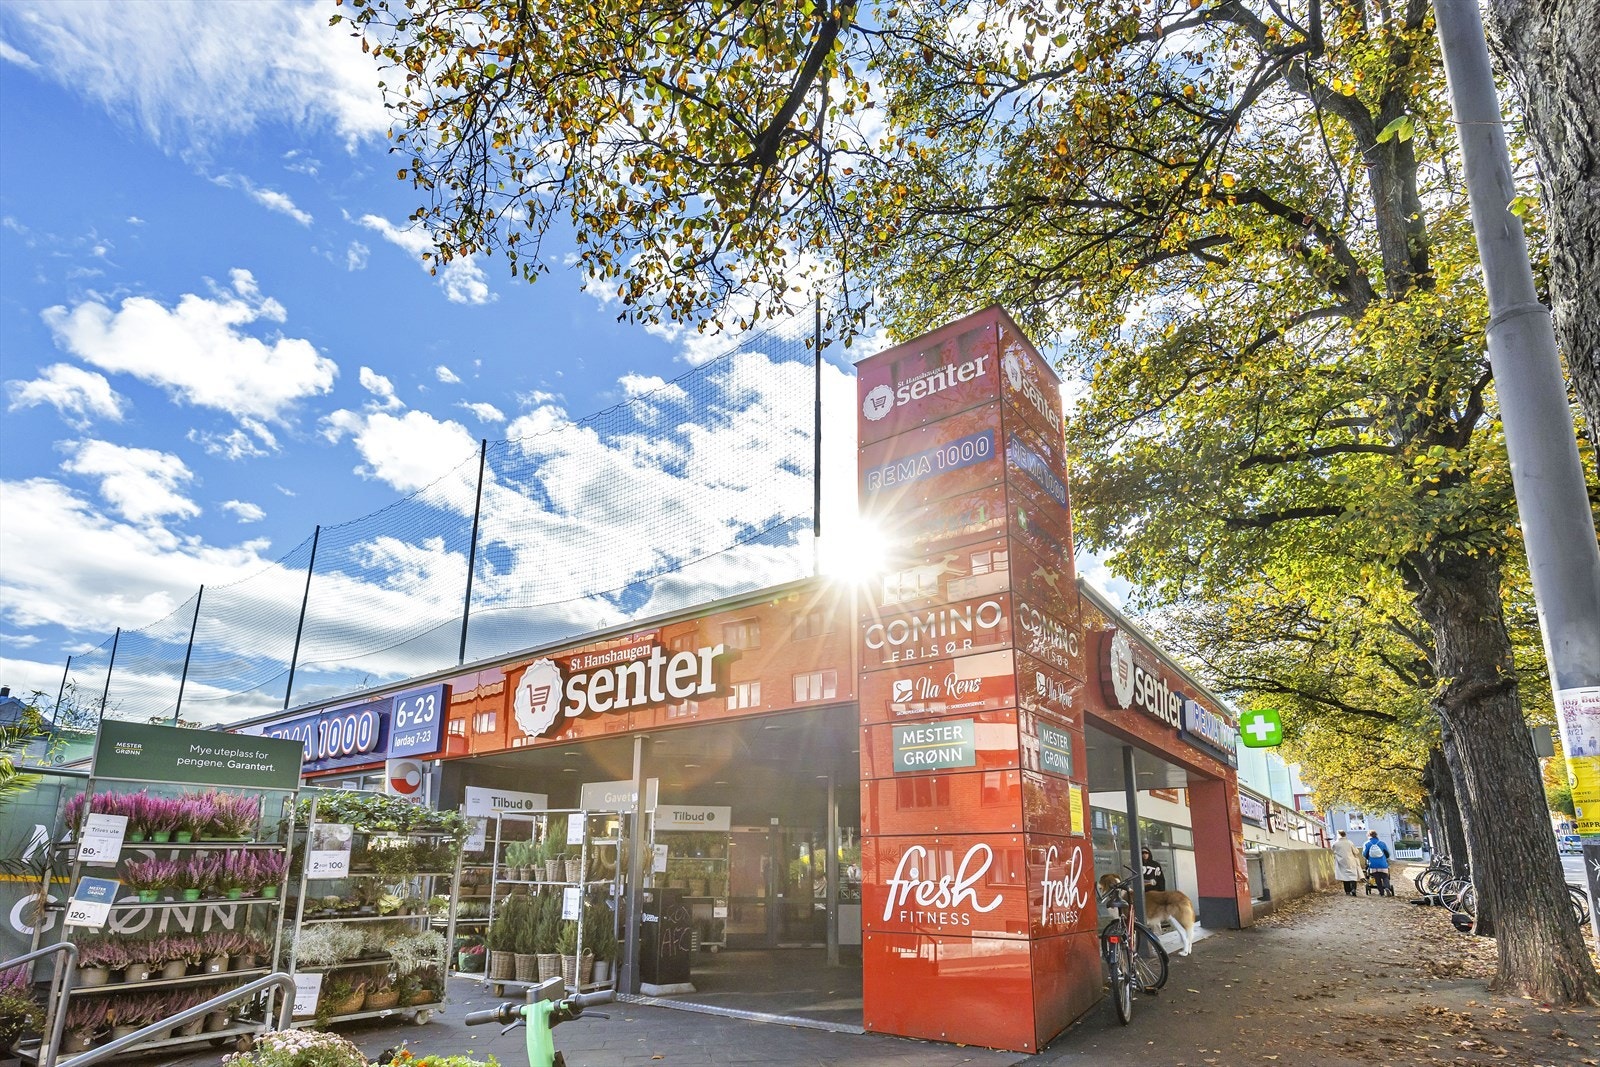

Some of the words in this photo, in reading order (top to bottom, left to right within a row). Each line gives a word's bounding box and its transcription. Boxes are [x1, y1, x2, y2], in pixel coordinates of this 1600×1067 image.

[896, 354, 989, 406] senter
[1021, 378, 1061, 434] senter
[868, 456, 931, 491] REMA
[936, 436, 989, 468] 1000
[865, 600, 1002, 650] COMINO
[1020, 602, 1079, 658] COMINO
[570, 658, 583, 672] St.
[584, 644, 651, 668] Hanshaugen
[564, 643, 724, 718] senter
[944, 672, 982, 700] Rens
[1135, 666, 1182, 731] senter
[396, 694, 435, 728] 6-23
[116, 741, 142, 749] MESTER
[318, 710, 376, 760] 1000
[416, 730, 432, 743] 7-23
[902, 725, 964, 745] MESTER
[1043, 728, 1069, 750] MESTER
[115, 748, 141, 756] GRØNN
[189, 744, 212, 757] Mye
[214, 747, 254, 760] uteplass
[254, 750, 269, 760] for
[903, 747, 963, 766] GRØNN
[1044, 750, 1070, 770] GRØNN
[176, 756, 225, 769] pengene.
[227, 759, 276, 772] Garantert.
[491, 796, 523, 809] Tilbud
[604, 791, 631, 804] Gavet
[672, 811, 705, 822] Tilbud
[82, 847, 101, 856] 80,-
[313, 862, 319, 870] 2
[883, 842, 1004, 922] fresh
[1041, 845, 1088, 927] fresh
[9, 893, 238, 935] GØNN
[69, 911, 91, 920] 120,-
[900, 910, 970, 926] FITNESS
[1049, 910, 1079, 926] FITNESS
